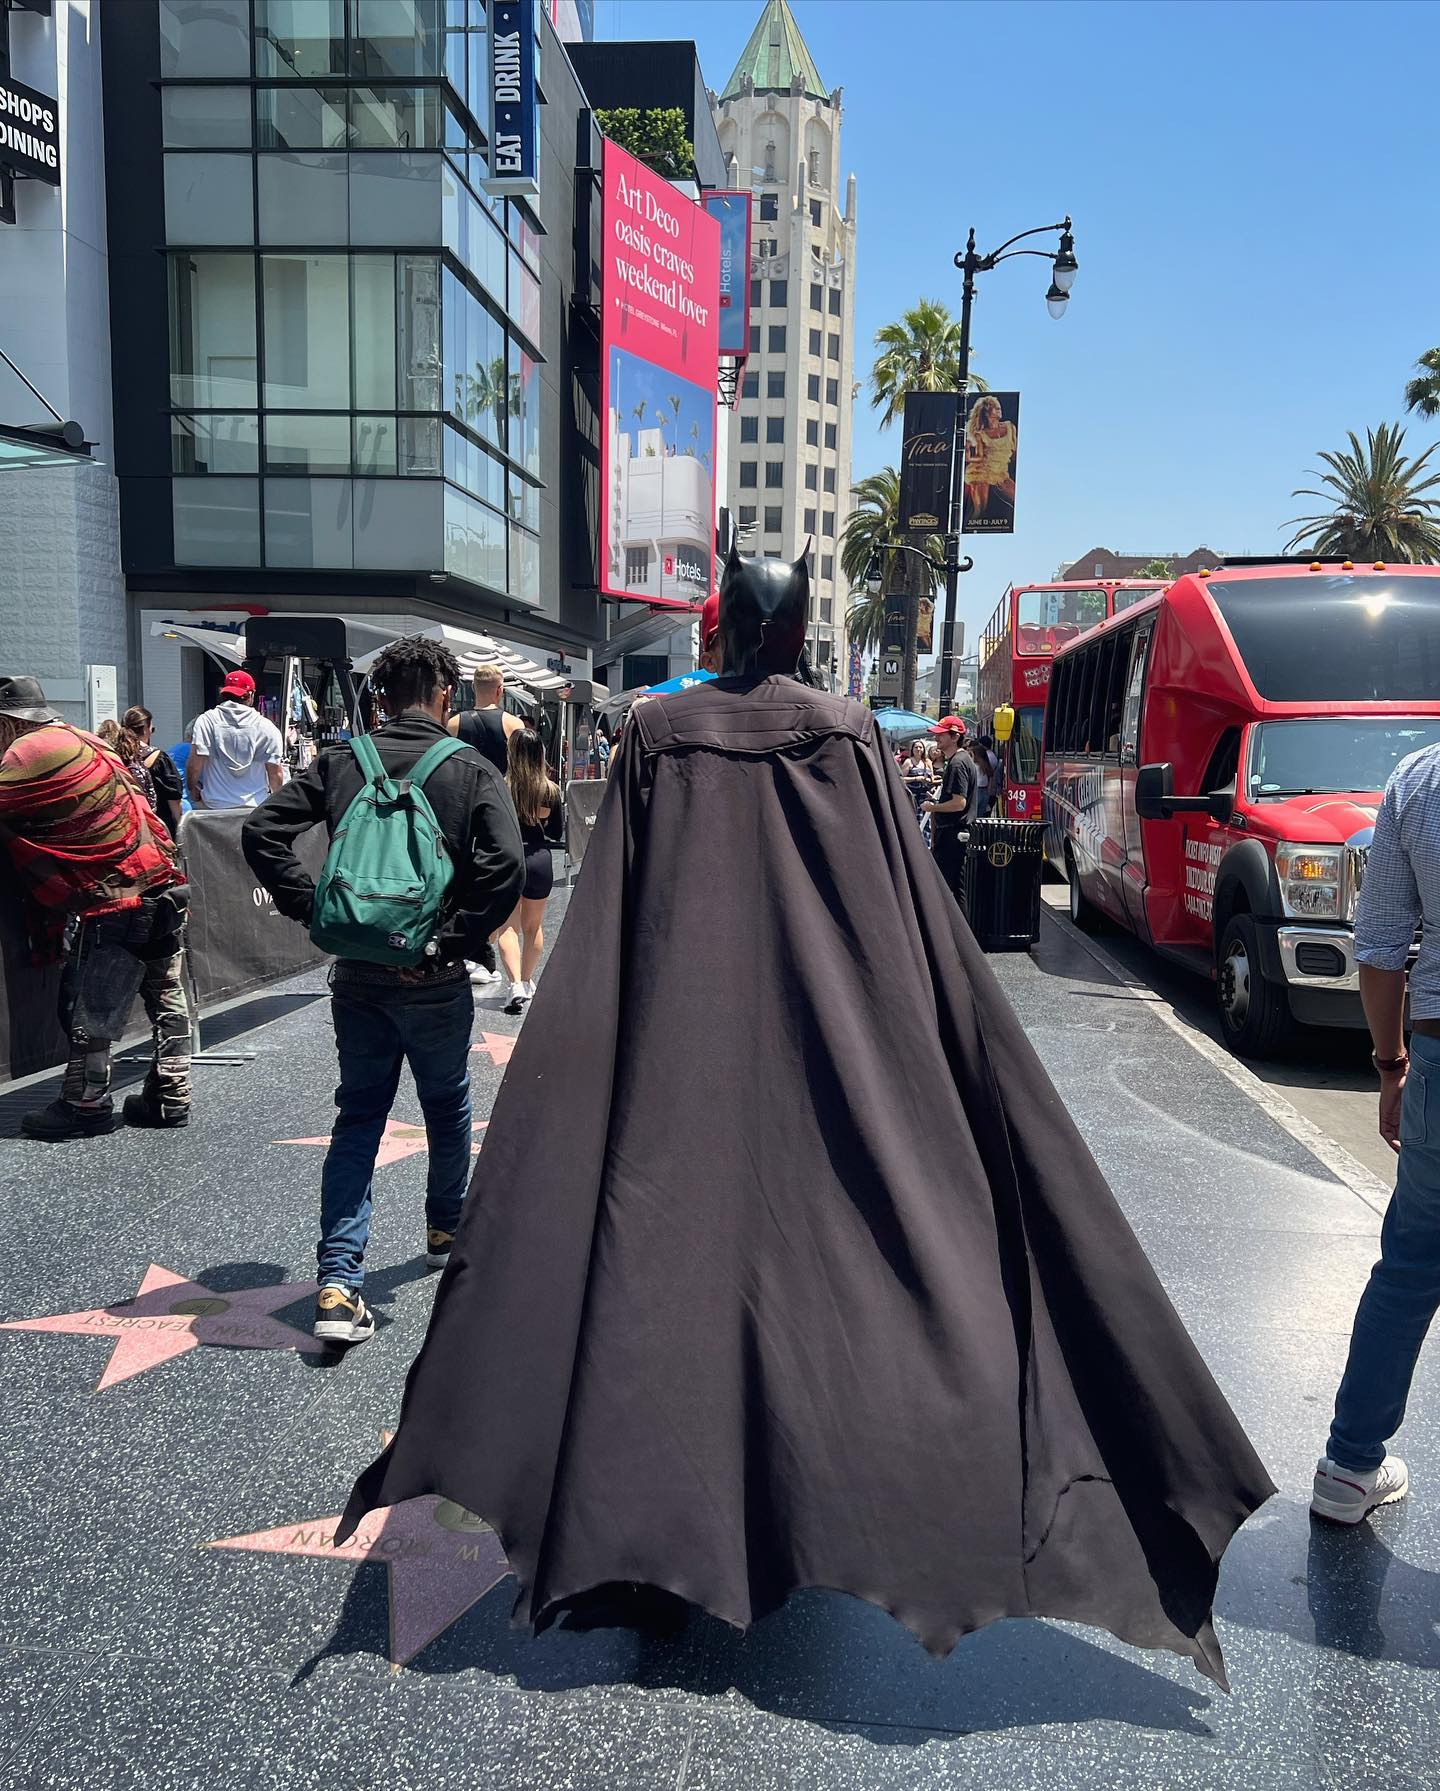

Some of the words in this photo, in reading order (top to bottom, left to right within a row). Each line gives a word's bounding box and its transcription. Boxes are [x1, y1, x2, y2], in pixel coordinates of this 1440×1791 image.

[494, 31, 520, 102] DRINK
[496, 132, 521, 171] EAT
[616, 173, 642, 215] Art
[646, 191, 680, 238] Deco
[615, 219, 650, 257] oasis
[653, 243, 694, 284] craves
[615, 257, 676, 308] weekend
[679, 284, 708, 327] lover
[903, 433, 951, 460] Tina
[886, 662, 897, 673] M
[1008, 789, 1026, 801] 349
